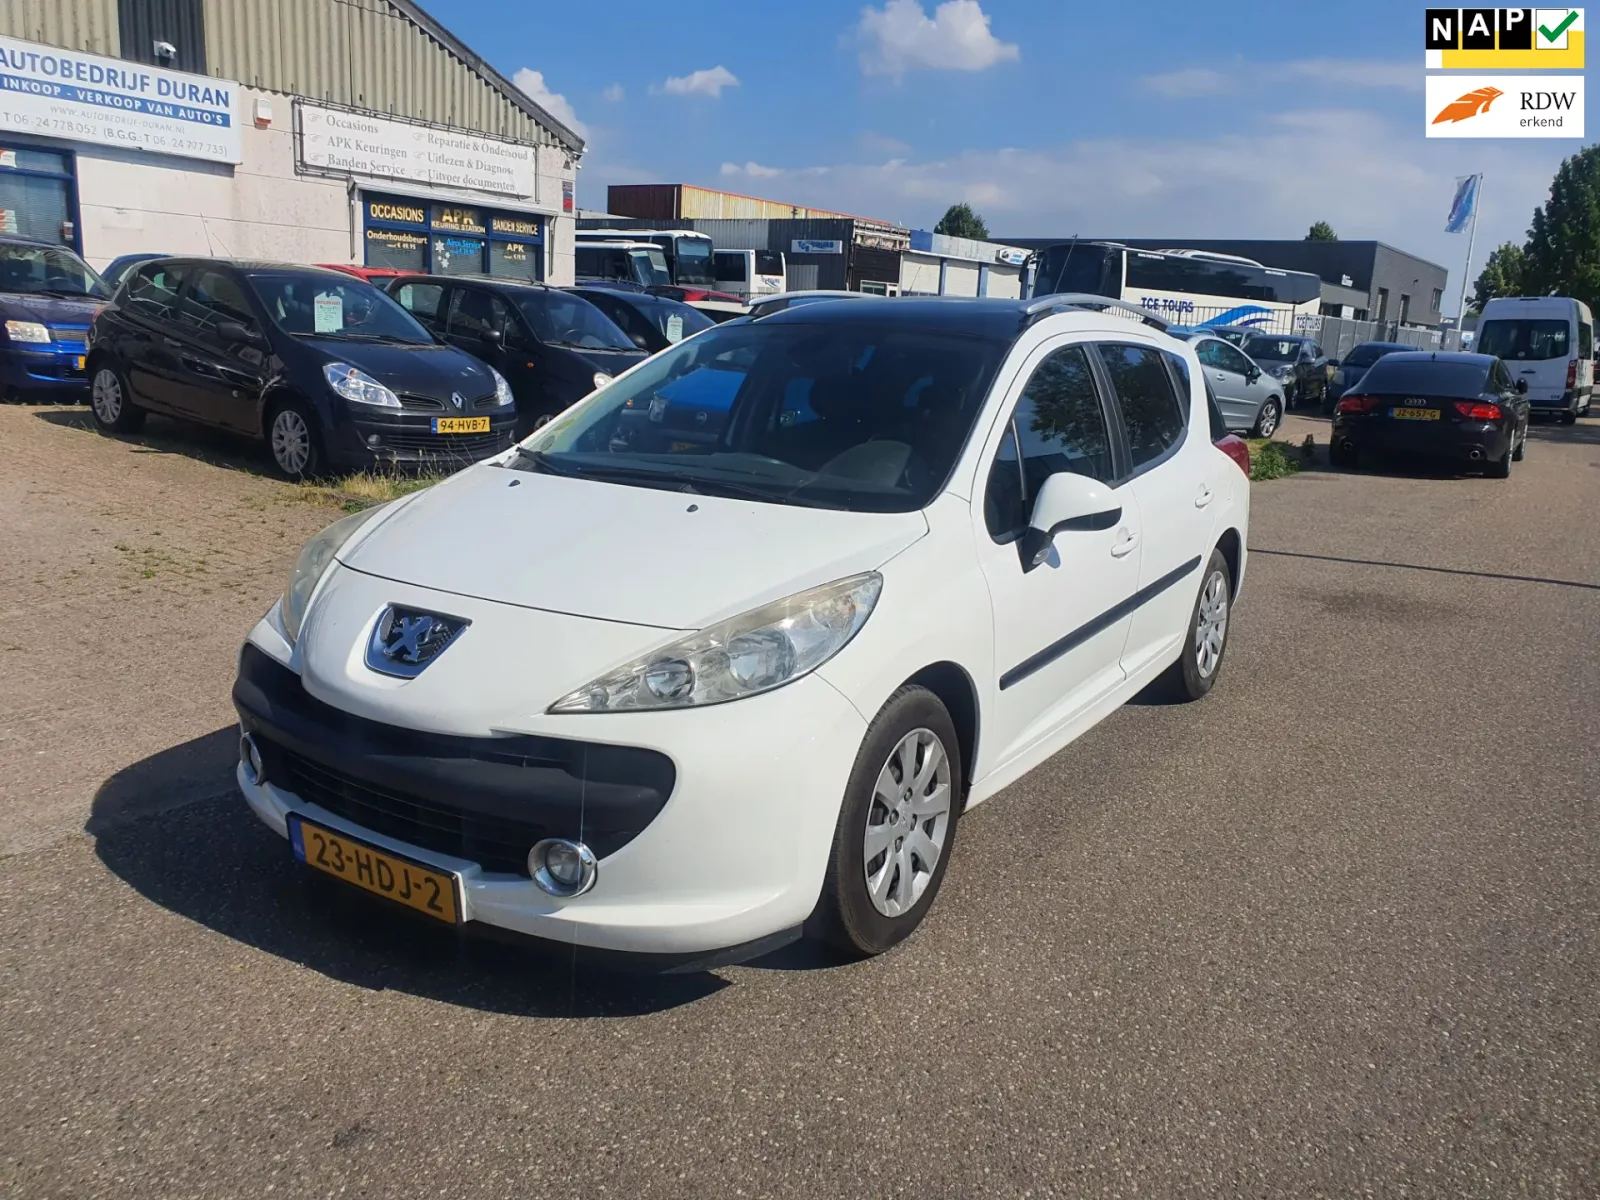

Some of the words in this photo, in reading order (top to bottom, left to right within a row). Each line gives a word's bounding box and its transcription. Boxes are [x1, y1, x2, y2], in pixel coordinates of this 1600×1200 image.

[0, 47, 150, 92] AUTOBEDRIJF
[157, 77, 230, 108] DURAN
[3, 77, 61, 96] INKOOP
[77, 90, 142, 110] VERKOOP
[147, 102, 173, 116] VAN
[178, 109, 223, 125] AUTO'S
[326, 114, 379, 134] Occasions
[327, 136, 352, 150] APK
[355, 139, 407, 159] Keuringen
[427, 133, 471, 150] Reparatie
[472, 144, 480, 152] &
[481, 143, 528, 160] Onderhoud
[328, 153, 367, 170] Banden
[370, 159, 405, 175] Service
[427, 152, 465, 168] Uitlezen
[466, 159, 474, 169] &
[428, 169, 461, 183] Uitvoer
[370, 204, 424, 223] OCCASIONS
[442, 208, 474, 225] APK
[431, 220, 460, 231] KEURING
[461, 224, 486, 233] STATION
[492, 219, 514, 232] BANDEN
[516, 221, 538, 235] SERVICE
[366, 230, 428, 245] Onderhoudsbeurt
[506, 242, 525, 253] APK
[1141, 296, 1160, 311] TCE
[1162, 299, 1195, 313] TOURS
[440, 419, 487, 431] 94-HVB-7
[312, 832, 443, 913] 23-HDJ-2
